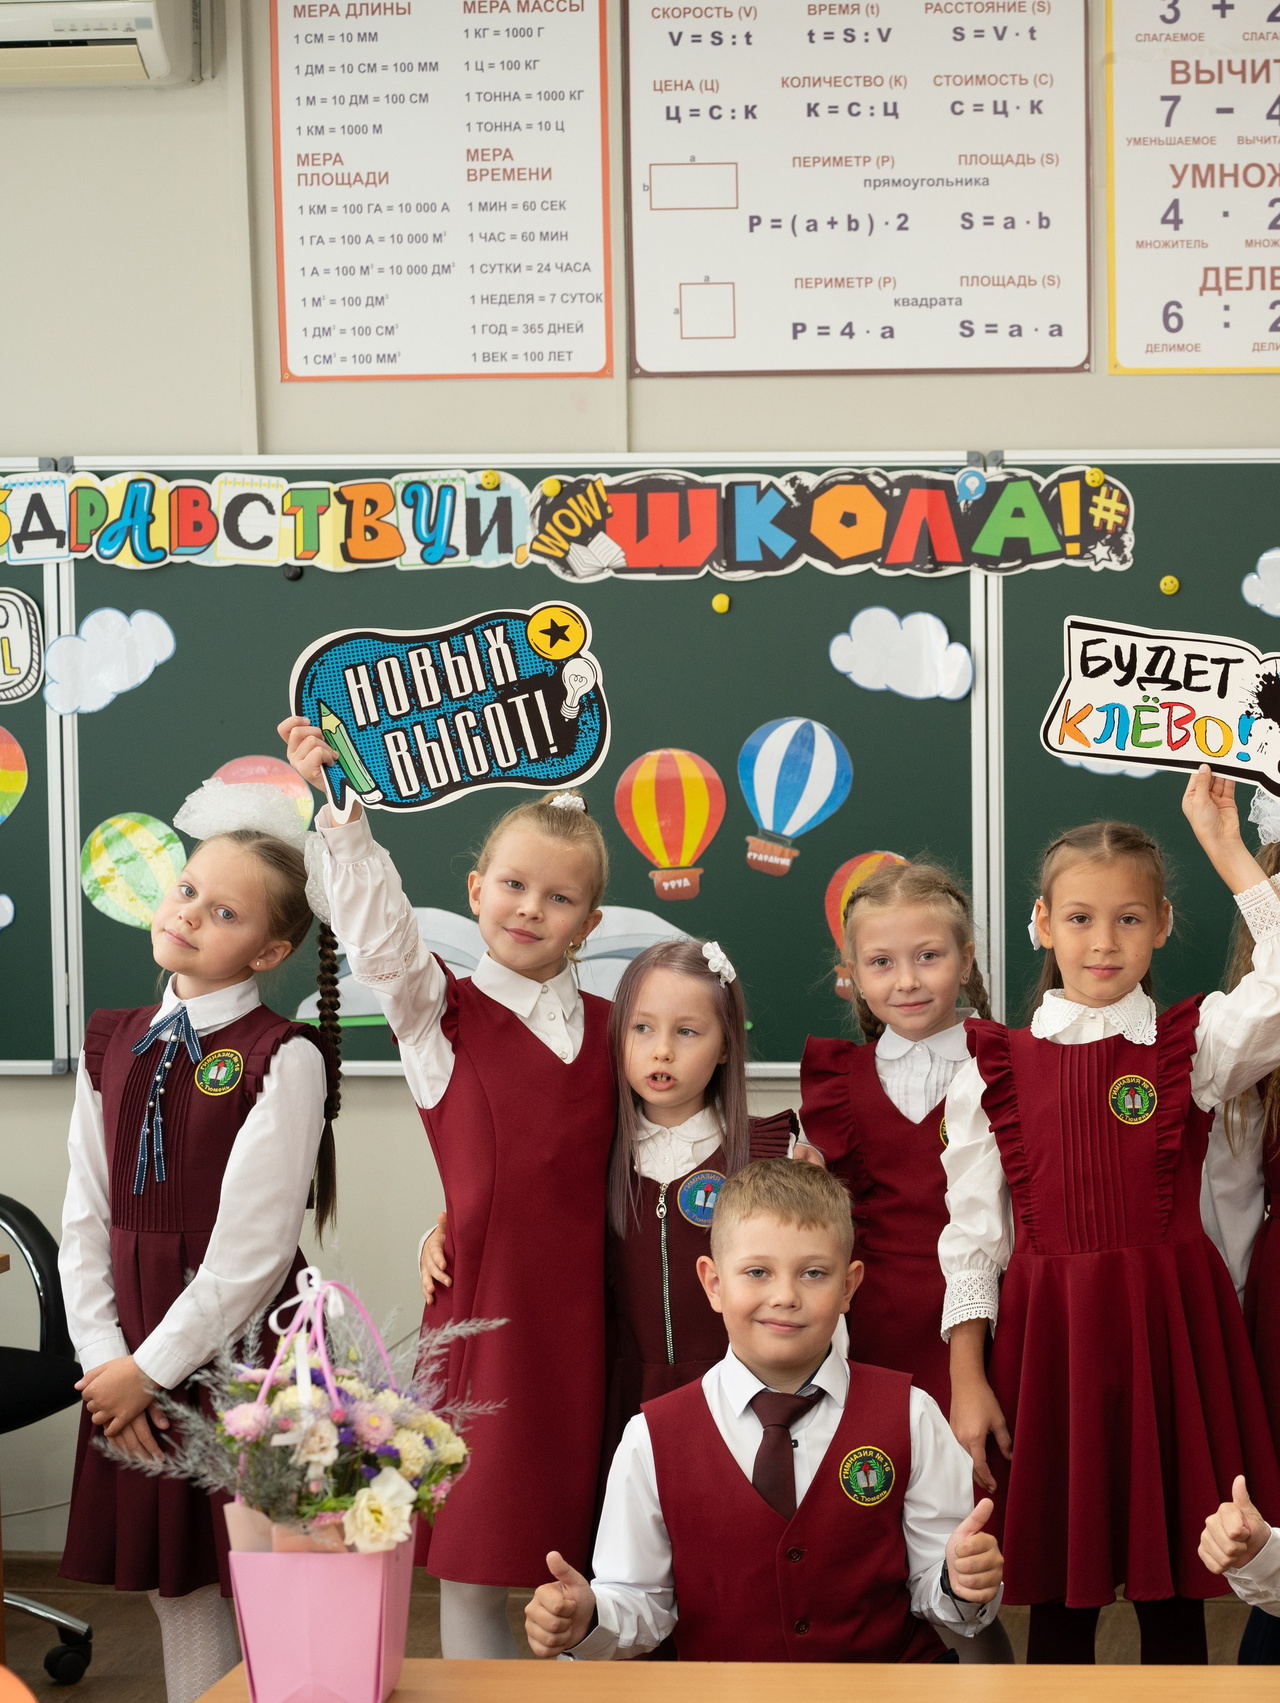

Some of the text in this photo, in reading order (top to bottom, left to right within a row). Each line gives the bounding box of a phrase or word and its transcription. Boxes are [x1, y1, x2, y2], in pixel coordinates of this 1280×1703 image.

[293, 1, 411, 20] МЕРА ДЛИНЫ
[463, 0, 584, 14] МЕРА МАССЫ
[651, 6, 734, 19] СКОРОСТЬ
[807, 3, 860, 16] ВРЕМЯ
[924, 0, 1027, 14] РАССТОЯНИЕ
[294, 34, 299, 44] 1
[304, 33, 324, 44] СМ
[339, 32, 353, 43] 10
[357, 32, 378, 42] ММ
[1135, 32, 1205, 43] СЛАГАЕМОЕ
[653, 79, 695, 94] ЦЕНА
[781, 75, 884, 88] КОЛИЧЕСТВО
[933, 74, 1029, 87] СТОИМОСТЬ
[465, 92, 470, 102] 1
[475, 91, 522, 102] ТОННА
[536, 90, 565, 102] 1000
[569, 90, 584, 101] КГ
[1160, 95, 1182, 128] 7
[1126, 136, 1217, 146] УМЕНЬШАЕМОЕ
[296, 152, 344, 167] МЕРА
[466, 148, 514, 162] МЕРА
[792, 155, 872, 168] ПЕРИМЕТР
[958, 153, 1036, 167] ПЛОЩАДЬ
[297, 171, 389, 188] ПЛОЩАДИ
[466, 167, 552, 182] ВРЕМЕНИ
[863, 177, 990, 191] прямоугольника
[1136, 239, 1209, 249] МНОЖИТЕЛЬ
[469, 264, 474, 274] 1
[479, 263, 522, 274] СУТКИ
[537, 262, 551, 273] 24
[555, 262, 592, 273] ЧАСА
[794, 276, 874, 289] ПЕРИМЕТР
[960, 275, 1038, 289] ПЛОЩАДЬ
[894, 296, 963, 309] квадрата
[1162, 300, 1184, 334] 6
[471, 324, 476, 335] 1
[481, 324, 508, 336] ГОД
[522, 323, 544, 334] 365
[547, 320, 584, 336] ДНЕЙ
[1144, 343, 1201, 354] ДЕЛИМОЕ
[472, 352, 477, 362] 1
[482, 351, 508, 363] ВЕК
[523, 351, 544, 362] 100
[548, 350, 573, 362] ЛЕТ
[532, 478, 612, 558] WOW!
[606, 480, 1081, 568] ШКОЛА!
[1080, 638, 1244, 699] БУДЕТ
[344, 626, 517, 726] НОВЫХ
[1058, 695, 1255, 762] КЛЁВО!
[383, 689, 558, 798] ВЫСОТ!
[843, 1450, 874, 1479] ГИМНАЗИЯ
